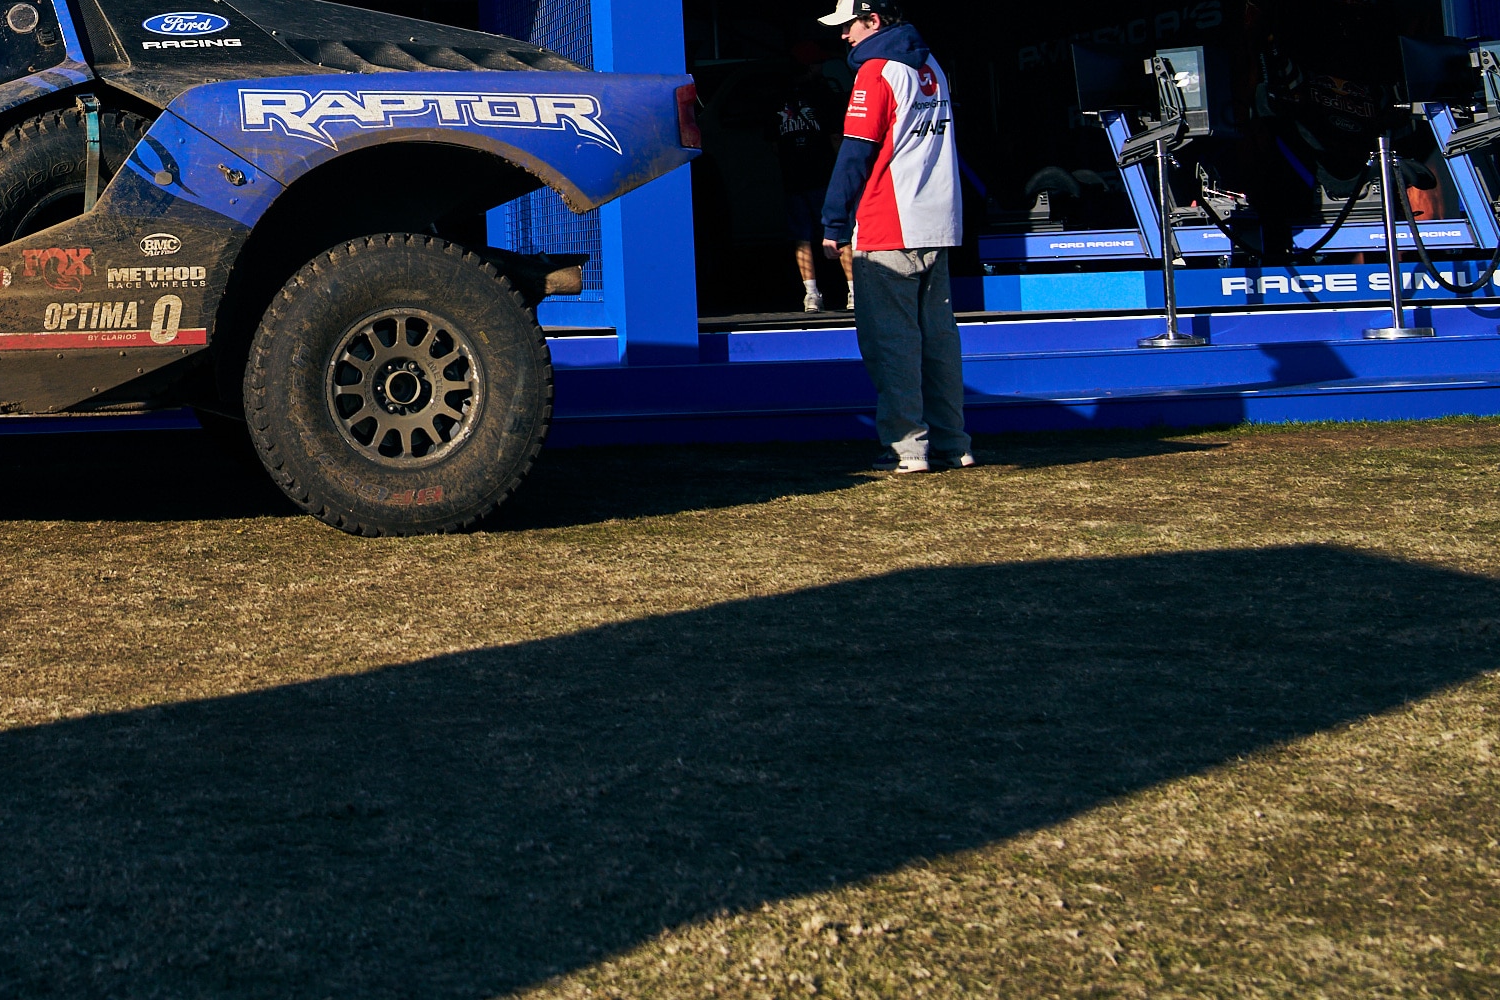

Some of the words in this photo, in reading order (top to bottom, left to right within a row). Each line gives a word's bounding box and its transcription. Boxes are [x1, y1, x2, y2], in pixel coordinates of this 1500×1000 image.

[160, 15, 212, 31] Ford
[142, 38, 242, 50] RACING
[1017, 0, 1224, 72] AMRICA'S
[238, 89, 622, 156] RAPTOR
[144, 239, 178, 251] BMC
[1050, 241, 1085, 249] FORD
[1086, 240, 1134, 248] RACING
[22, 248, 92, 293] FOX
[107, 266, 206, 282] METHOD
[150, 280, 206, 288] WHEELS
[1221, 273, 1357, 296] RACE
[43, 301, 138, 331] OPTIMA
[101, 332, 138, 341] CLARIOS
